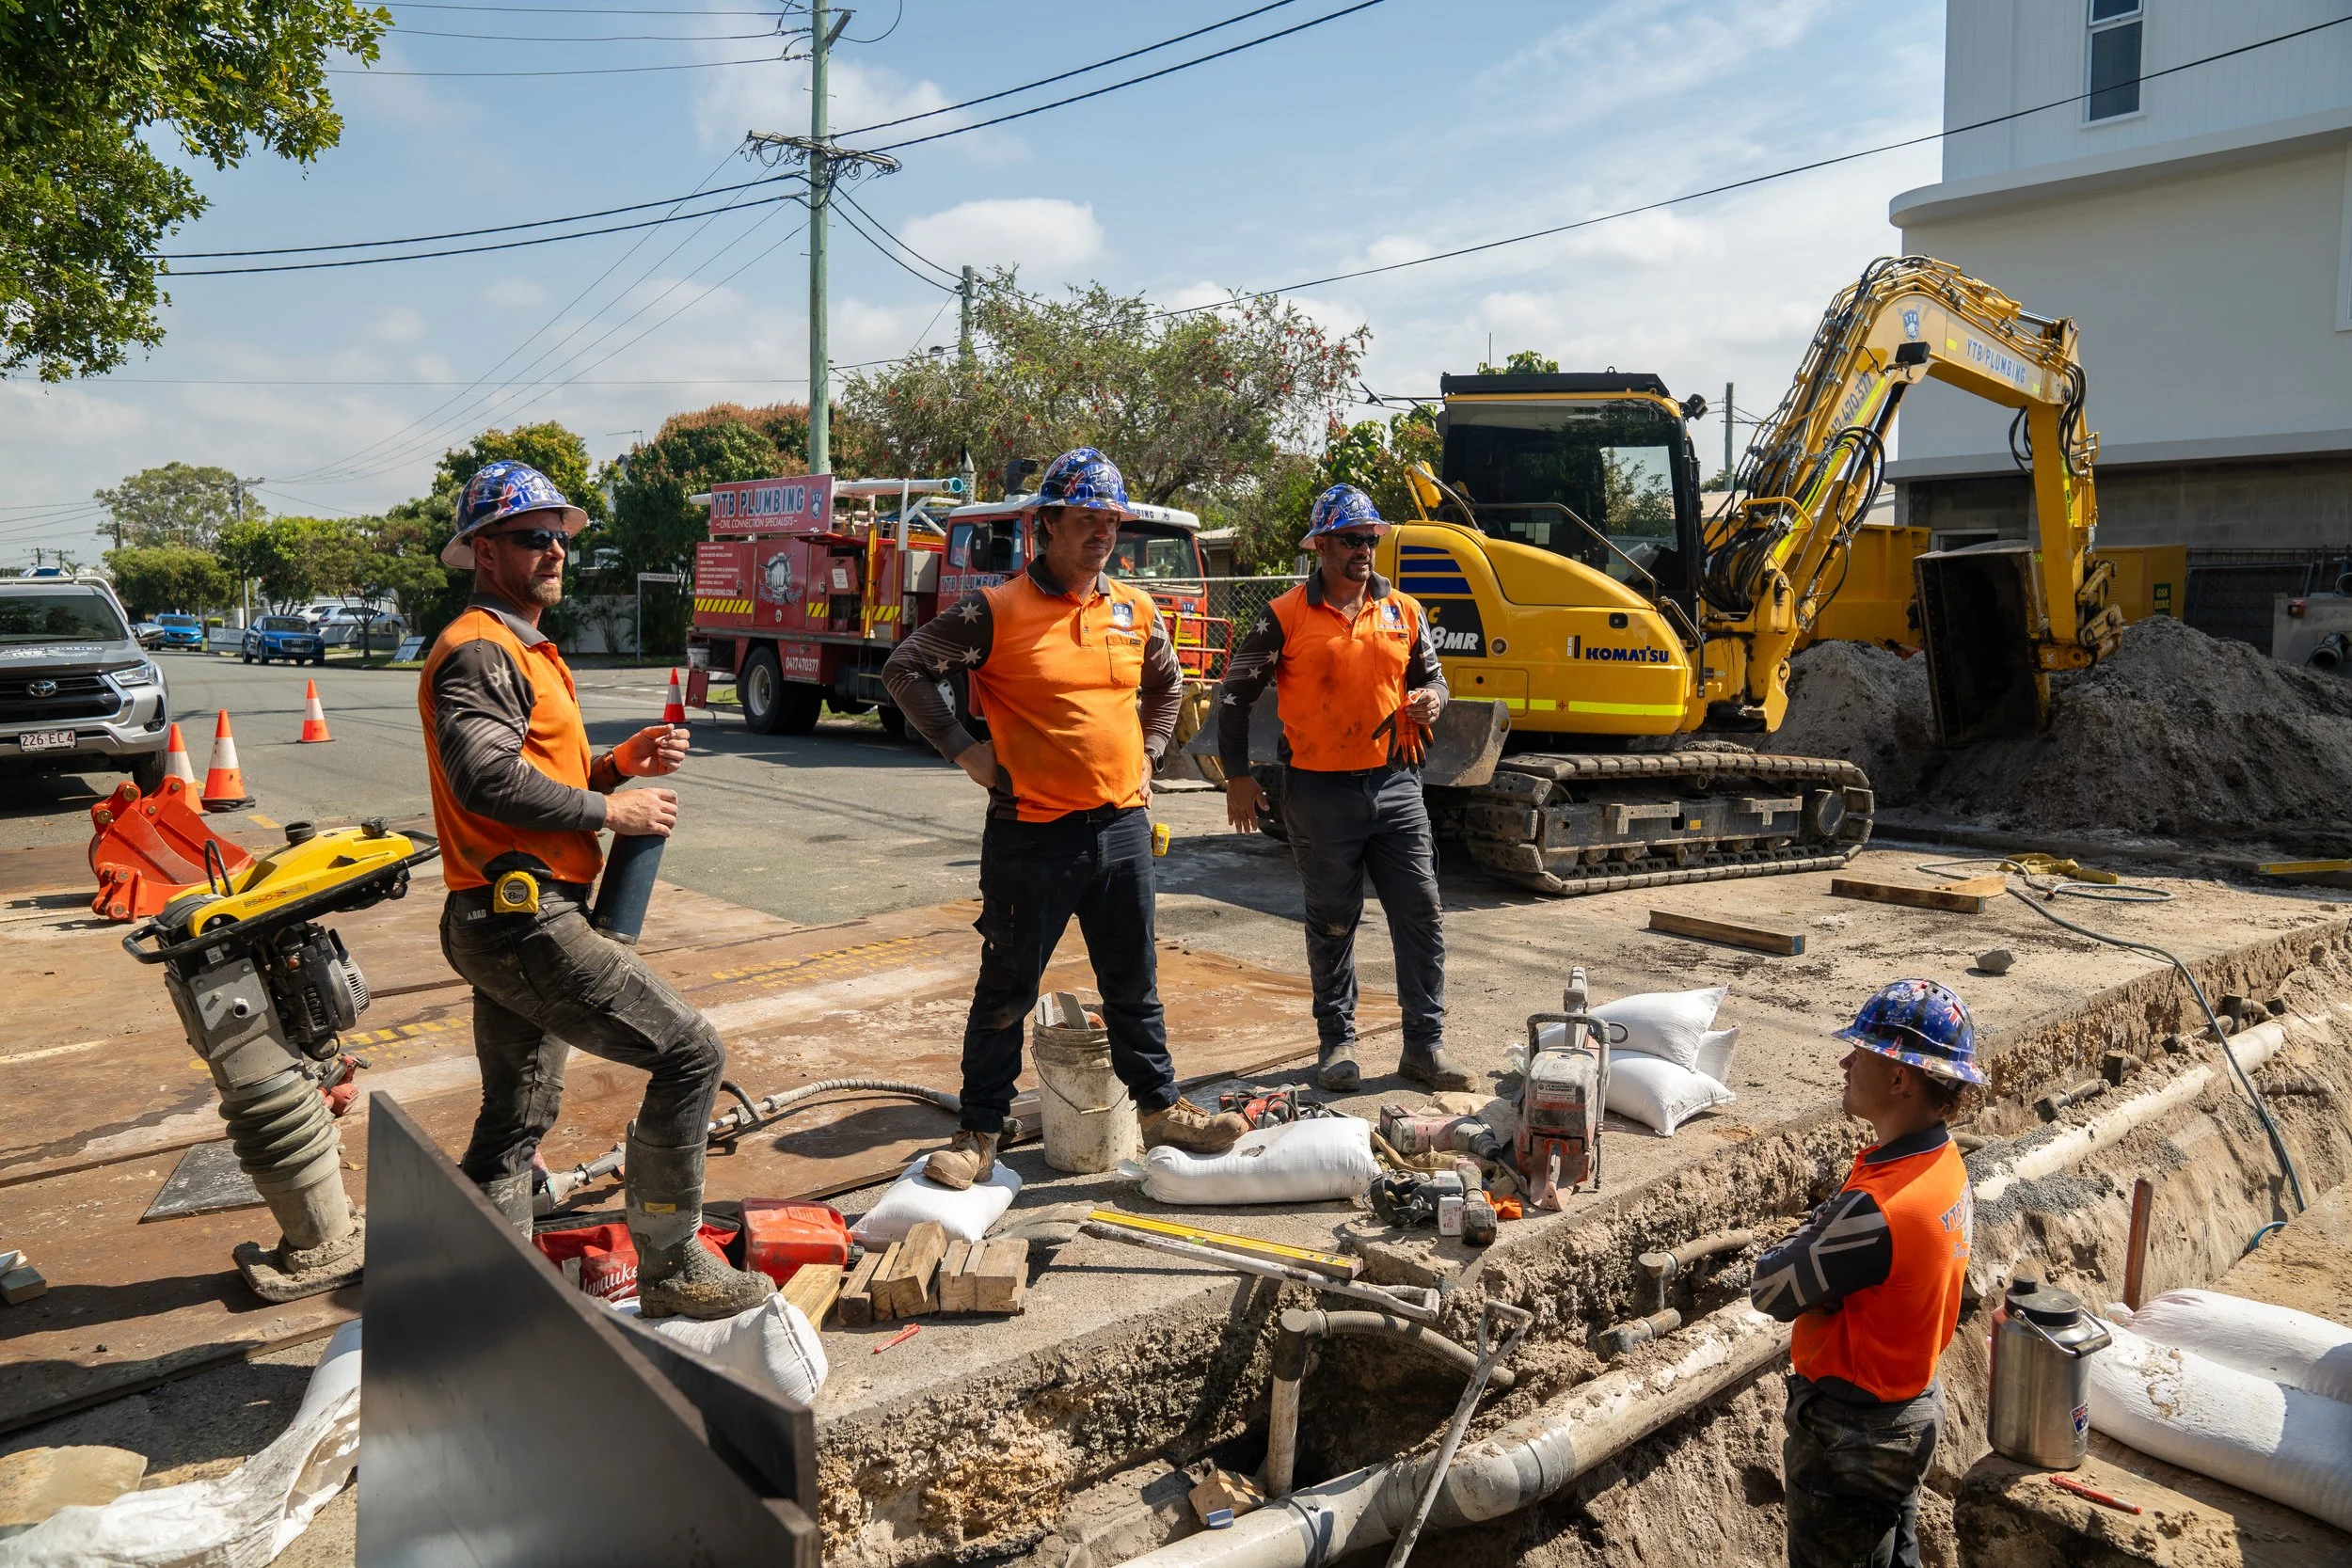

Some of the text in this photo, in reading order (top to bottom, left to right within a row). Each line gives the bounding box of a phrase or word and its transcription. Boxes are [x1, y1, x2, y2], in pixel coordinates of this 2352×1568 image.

[1966, 338, 2026, 384] YTB PLUMBING
[713, 484, 804, 518] YTB PLUMBING
[732, 518, 764, 528] CONNECTION
[765, 516, 793, 527] SPECIALISTS
[941, 576, 956, 592] YTB
[1430, 626, 1479, 650] 8MR
[1586, 645, 1669, 662] KOMATSU
[22, 731, 73, 747] 226 EC4
[583, 1263, 638, 1296] lwauke
